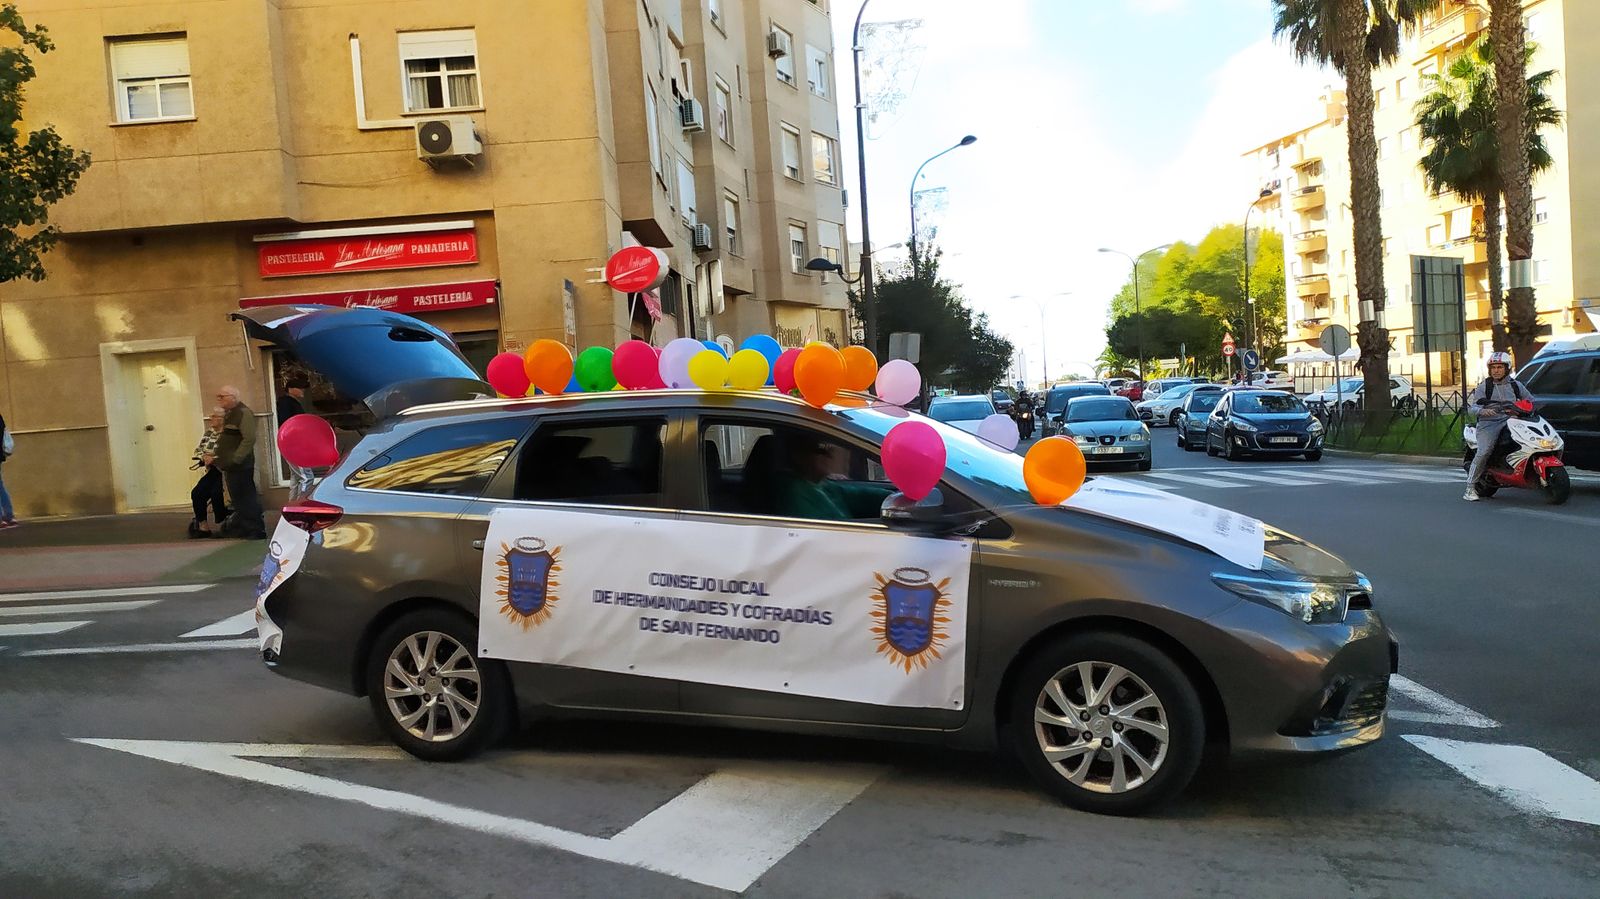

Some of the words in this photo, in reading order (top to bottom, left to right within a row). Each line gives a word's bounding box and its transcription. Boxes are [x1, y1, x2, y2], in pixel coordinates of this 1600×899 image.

[336, 242, 354, 262] La
[649, 571, 717, 593] CONSEJO
[719, 579, 770, 597] LOCAL
[592, 589, 613, 605] DE
[614, 591, 729, 617] HERMANDADES
[728, 603, 742, 618] Y
[742, 604, 834, 626] COFRADÍAS
[639, 616, 659, 632] DE
[662, 619, 694, 636] SAN
[696, 622, 781, 644] FERNANDO
